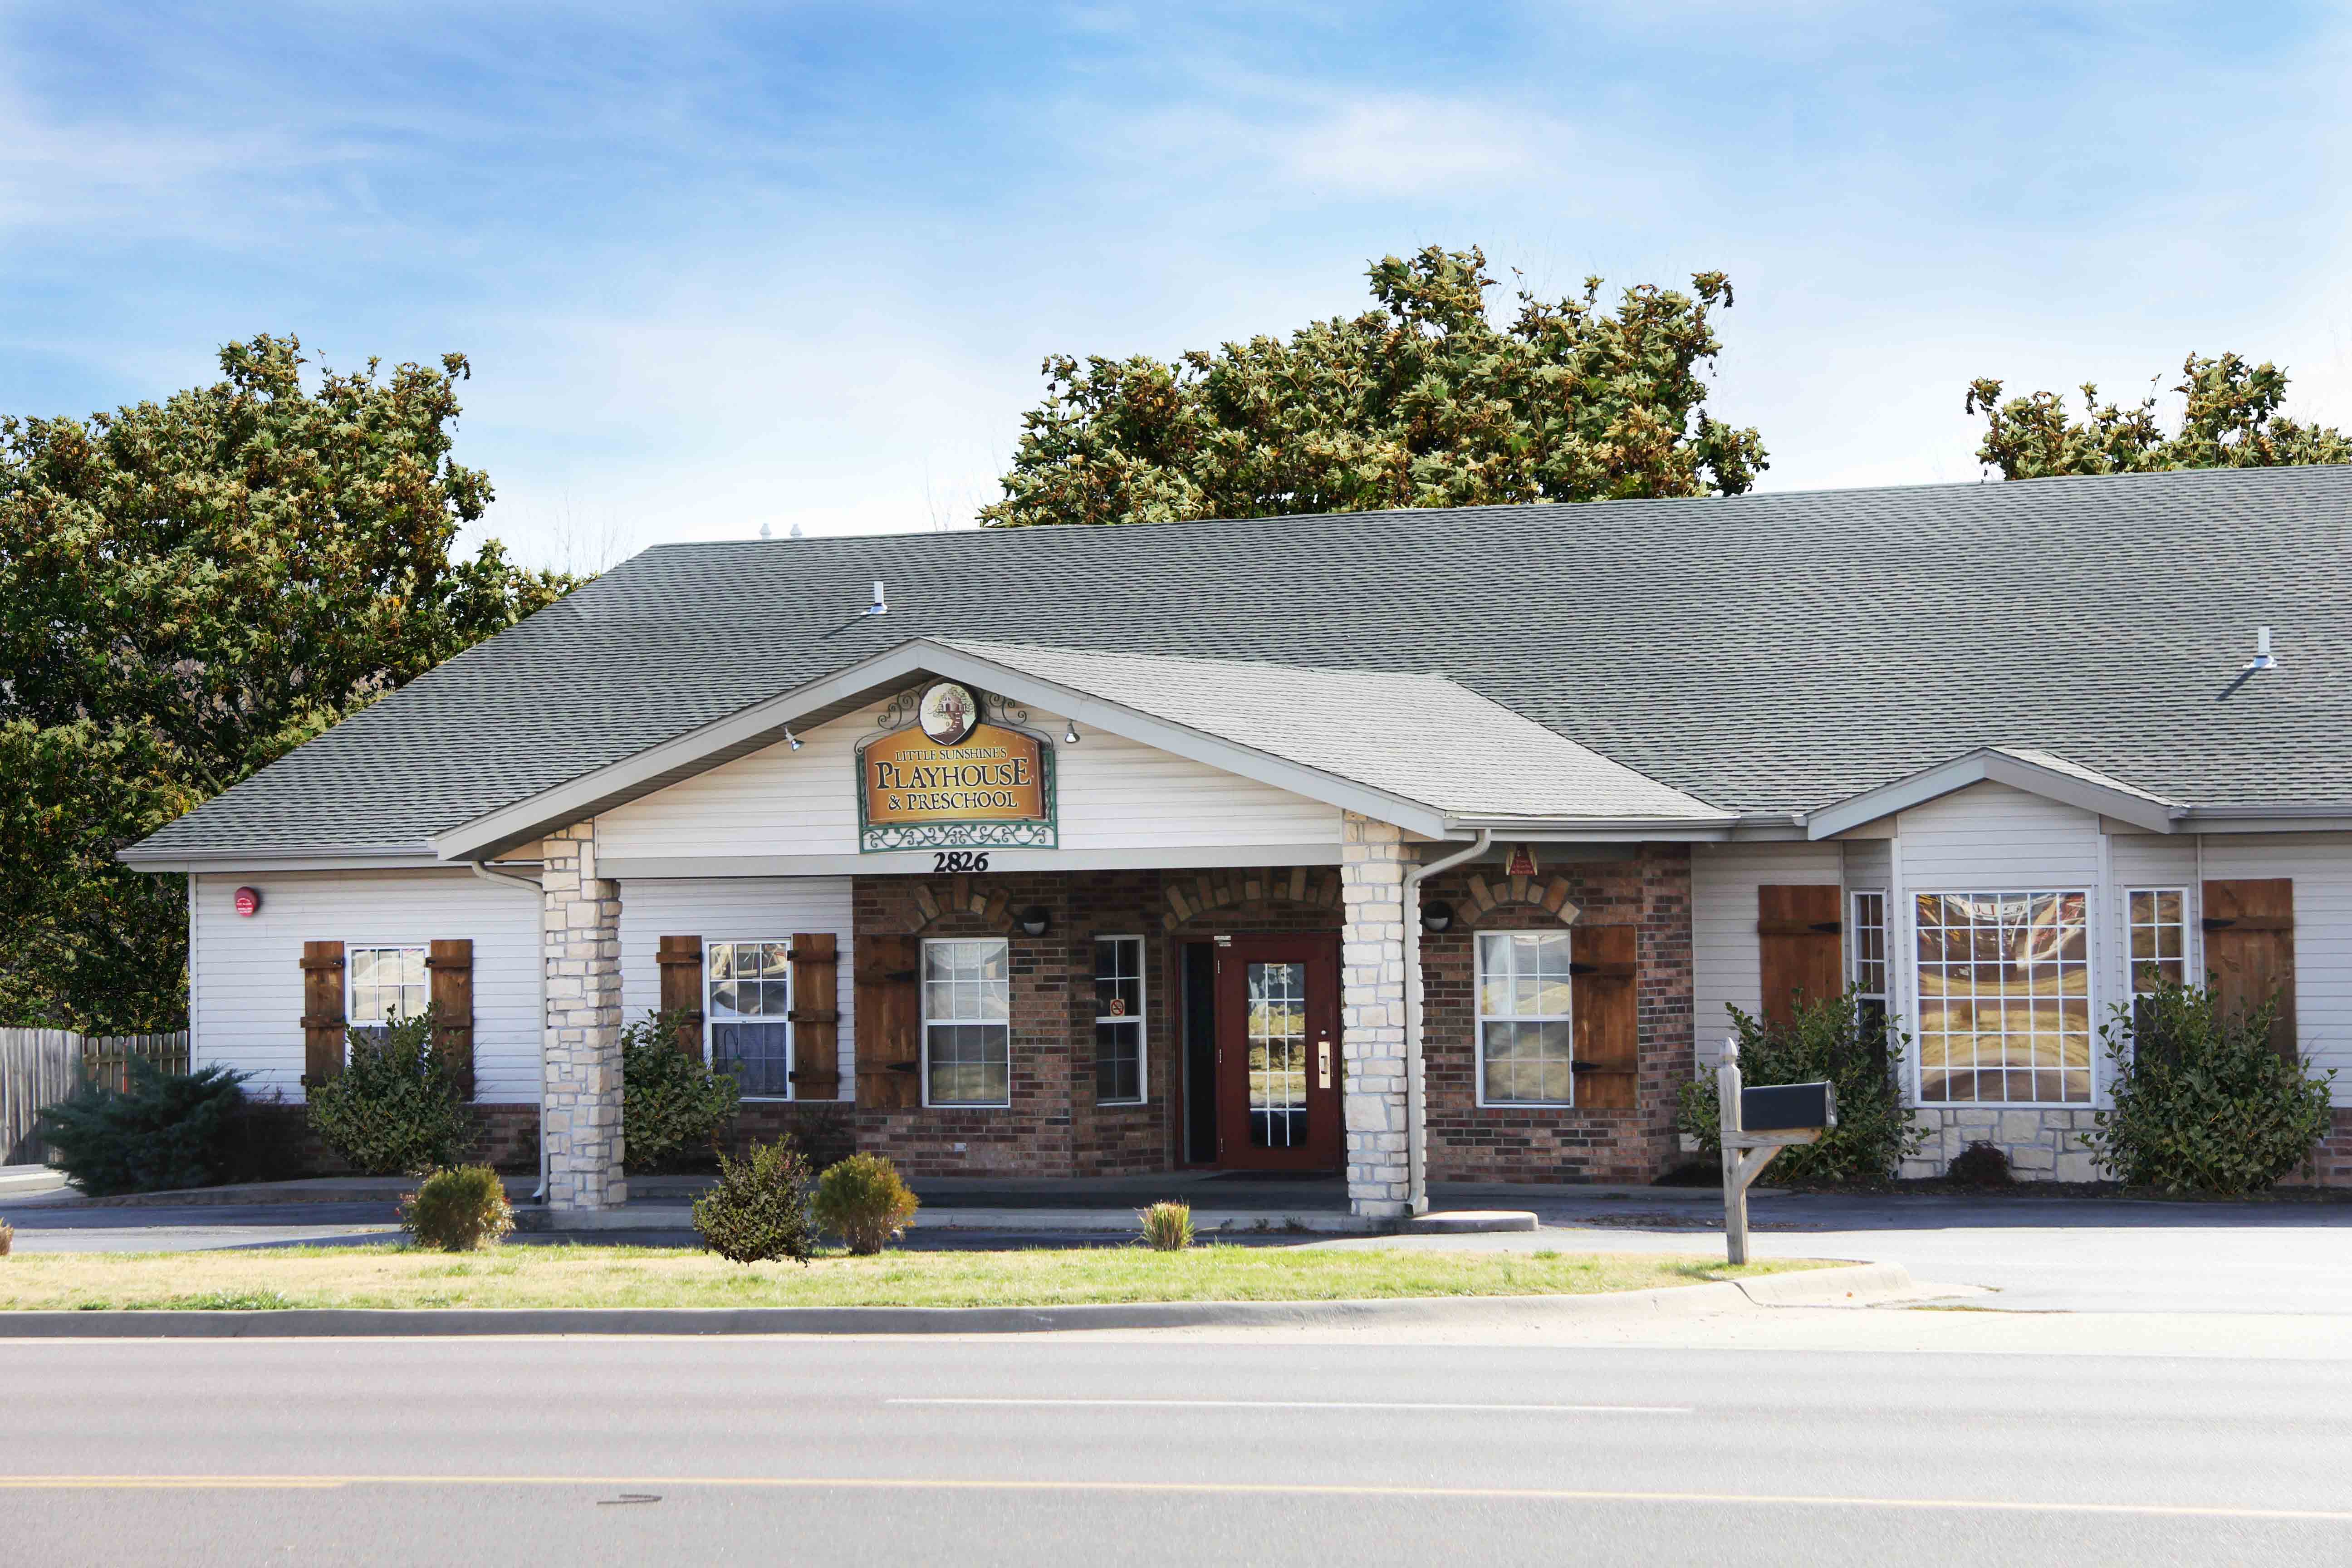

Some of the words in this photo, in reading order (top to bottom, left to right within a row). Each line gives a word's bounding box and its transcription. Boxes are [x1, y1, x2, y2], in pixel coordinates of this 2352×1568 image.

[896, 750, 936, 761] LITTLE
[940, 748, 1007, 760] SUNSHINE'S
[875, 758, 1030, 789] PLAYHOUSE
[888, 795, 902, 810] &
[906, 791, 1017, 810] PRESCHOOL
[934, 851, 989, 872] 2826
